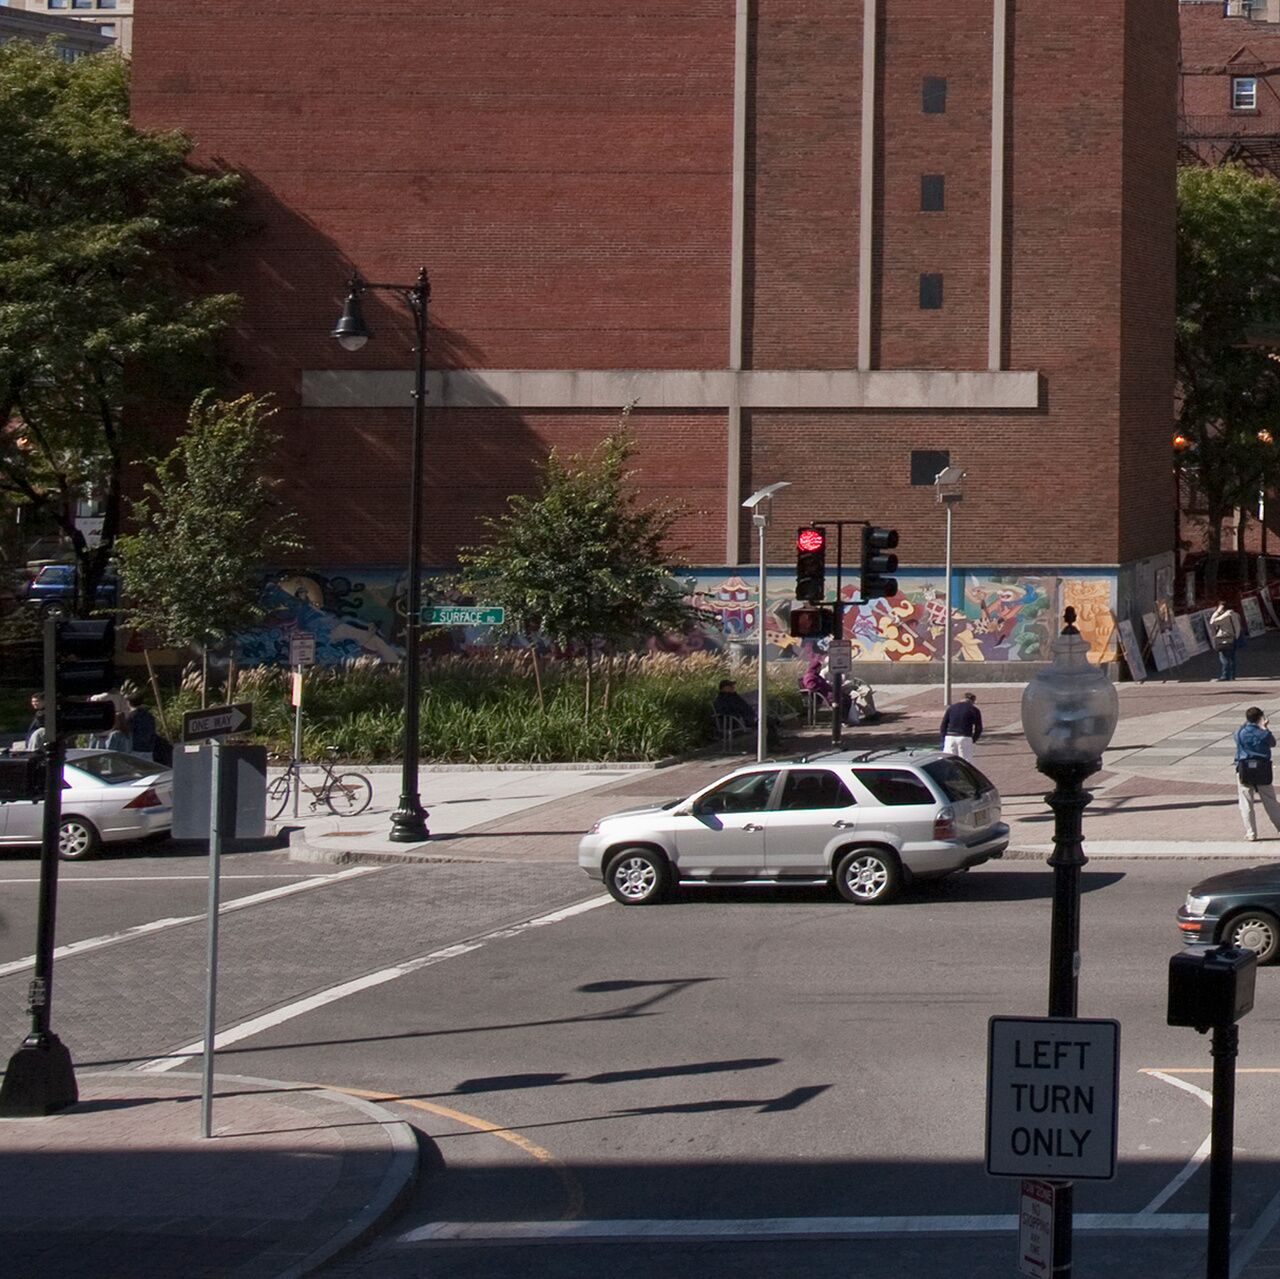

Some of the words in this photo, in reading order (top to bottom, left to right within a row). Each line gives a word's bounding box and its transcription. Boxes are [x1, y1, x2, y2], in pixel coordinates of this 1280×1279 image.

[440, 611, 483, 622] SURFACE
[191, 720, 209, 732] ONE
[214, 715, 232, 728] WAY
[1014, 1040, 1092, 1070] LEFT
[1010, 1083, 1095, 1115] TURN
[1011, 1127, 1093, 1158] ONLY
